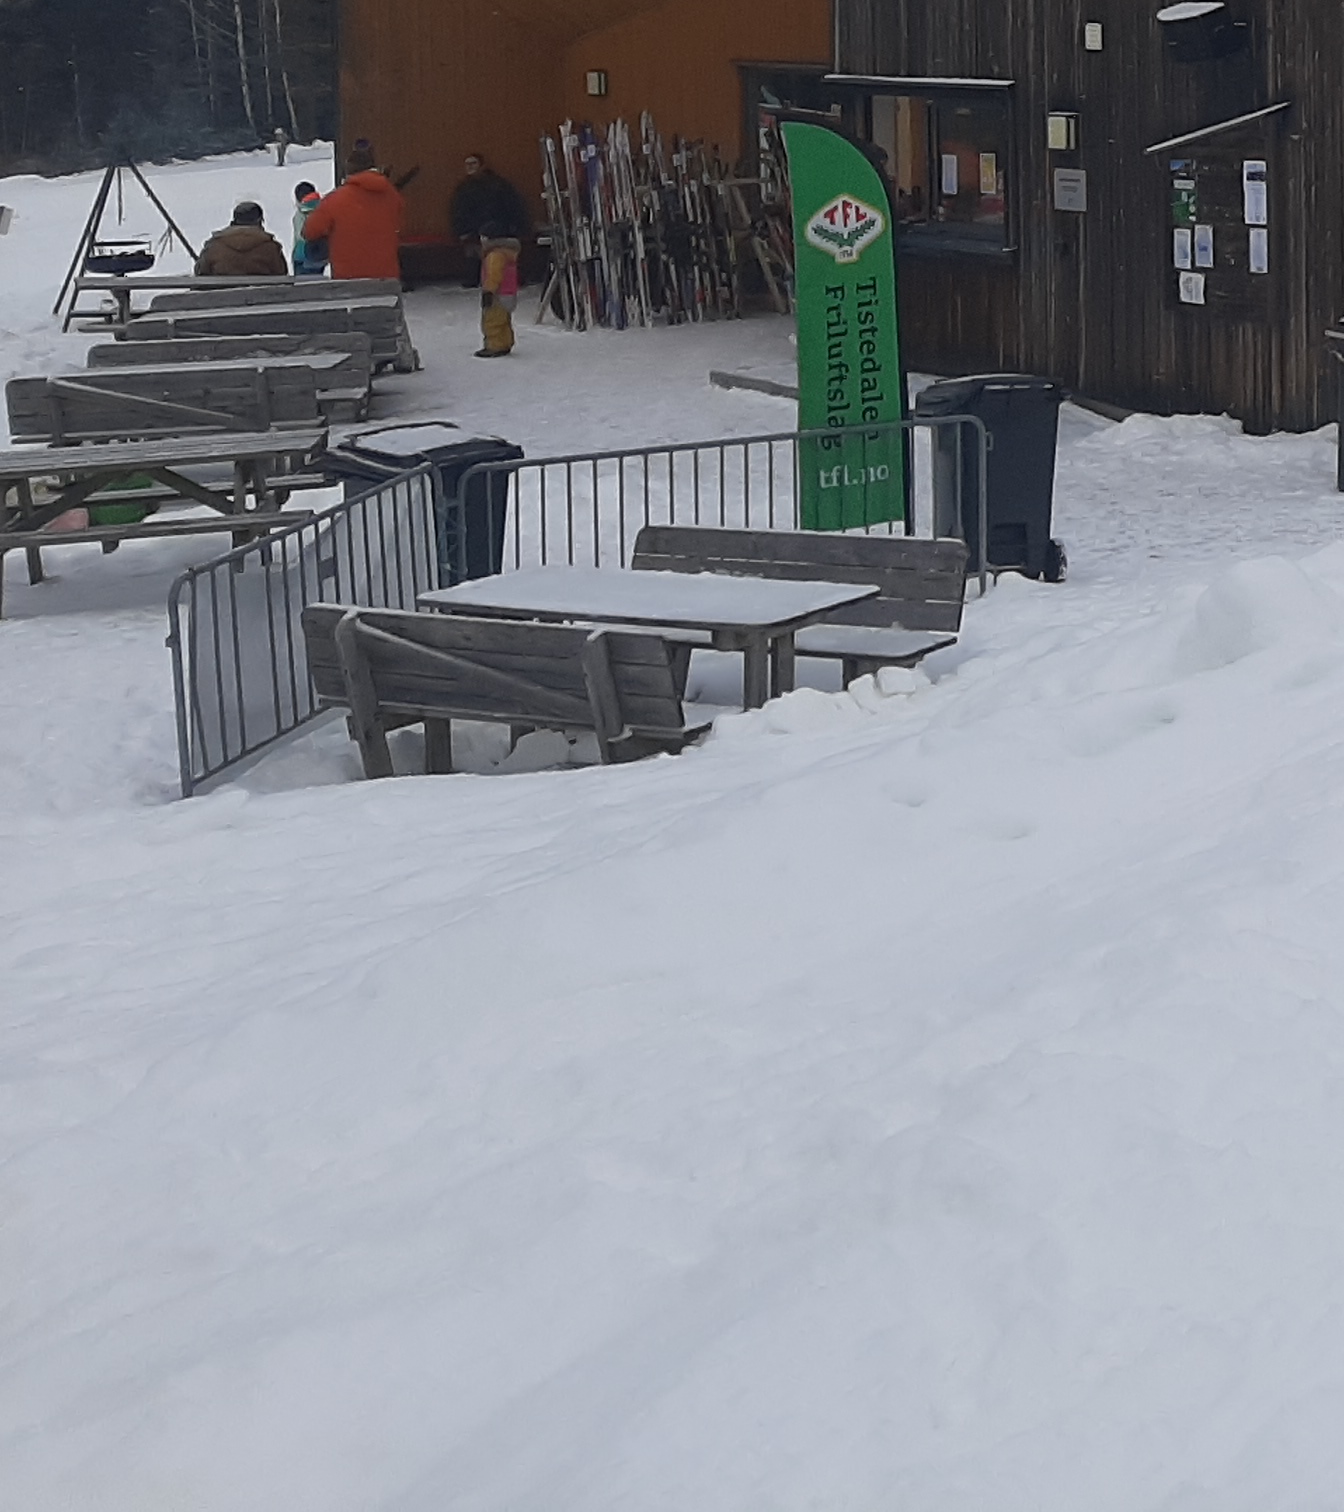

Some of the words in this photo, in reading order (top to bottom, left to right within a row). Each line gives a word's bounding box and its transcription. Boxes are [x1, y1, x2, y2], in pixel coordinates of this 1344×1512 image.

[824, 199, 867, 228] TFL
[822, 282, 851, 450] Friluftslag
[820, 464, 889, 488] tfl.no
